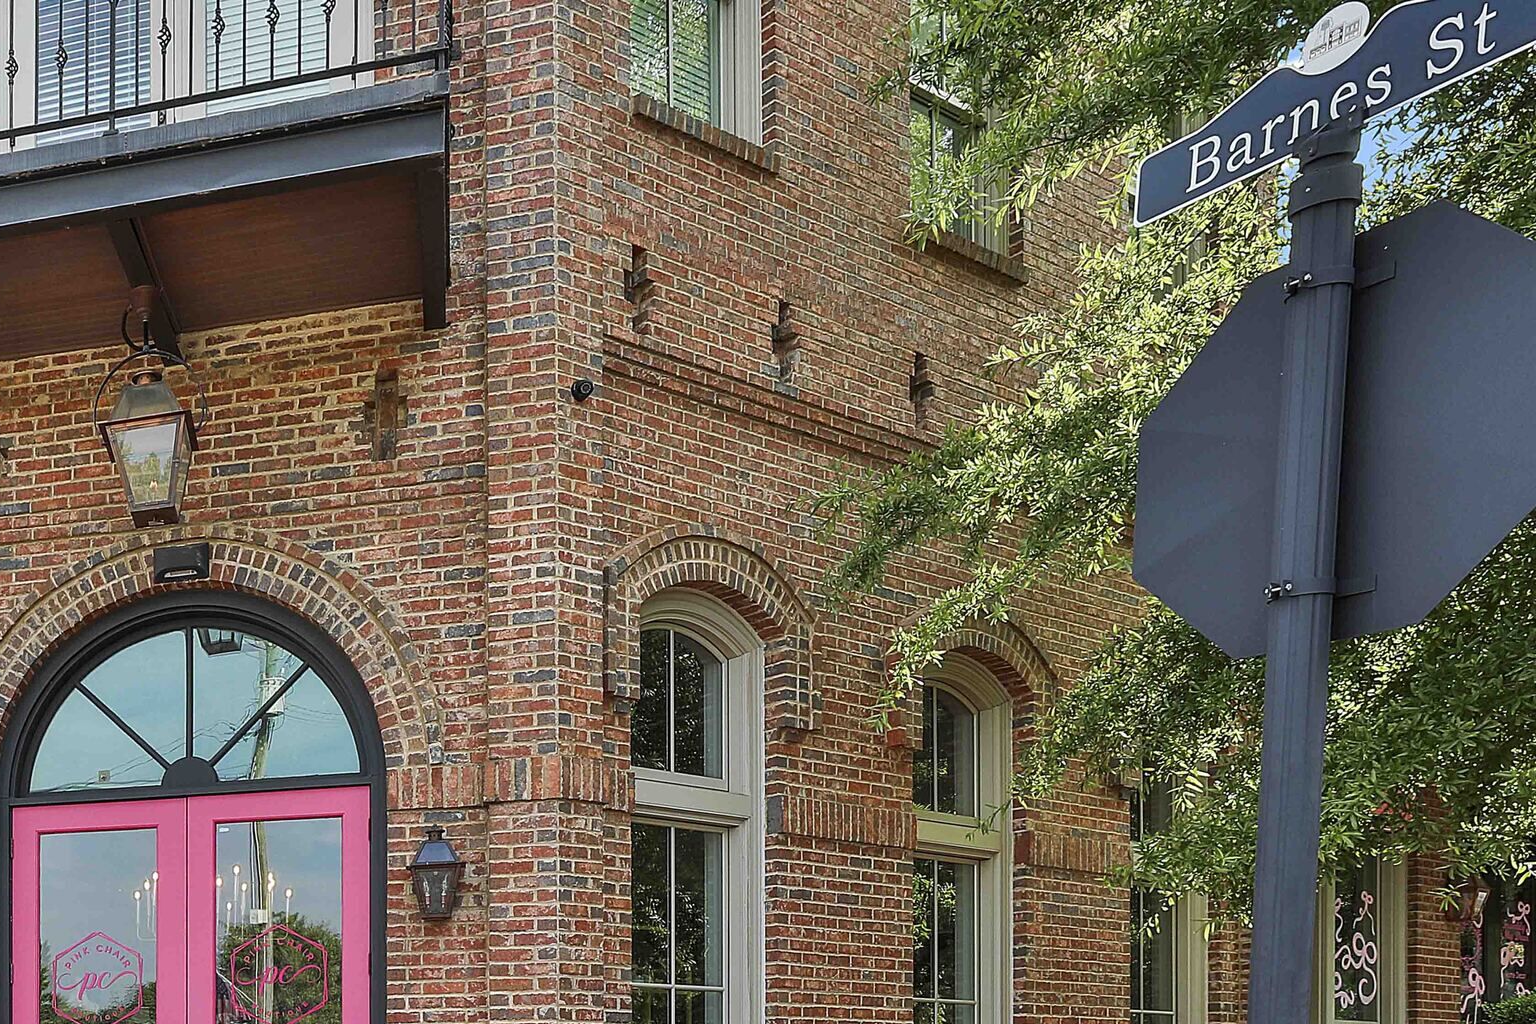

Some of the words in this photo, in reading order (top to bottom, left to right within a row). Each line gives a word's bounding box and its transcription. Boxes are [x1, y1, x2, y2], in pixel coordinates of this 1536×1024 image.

[1186, 63, 1392, 194] Barnes
[1425, 2, 1498, 80] St
[64, 946, 90, 970] PINK
[96, 944, 131, 968] CHAIR
[276, 938, 315, 961] CHAIR
[57, 970, 138, 1001] pc
[236, 964, 322, 995] pc
